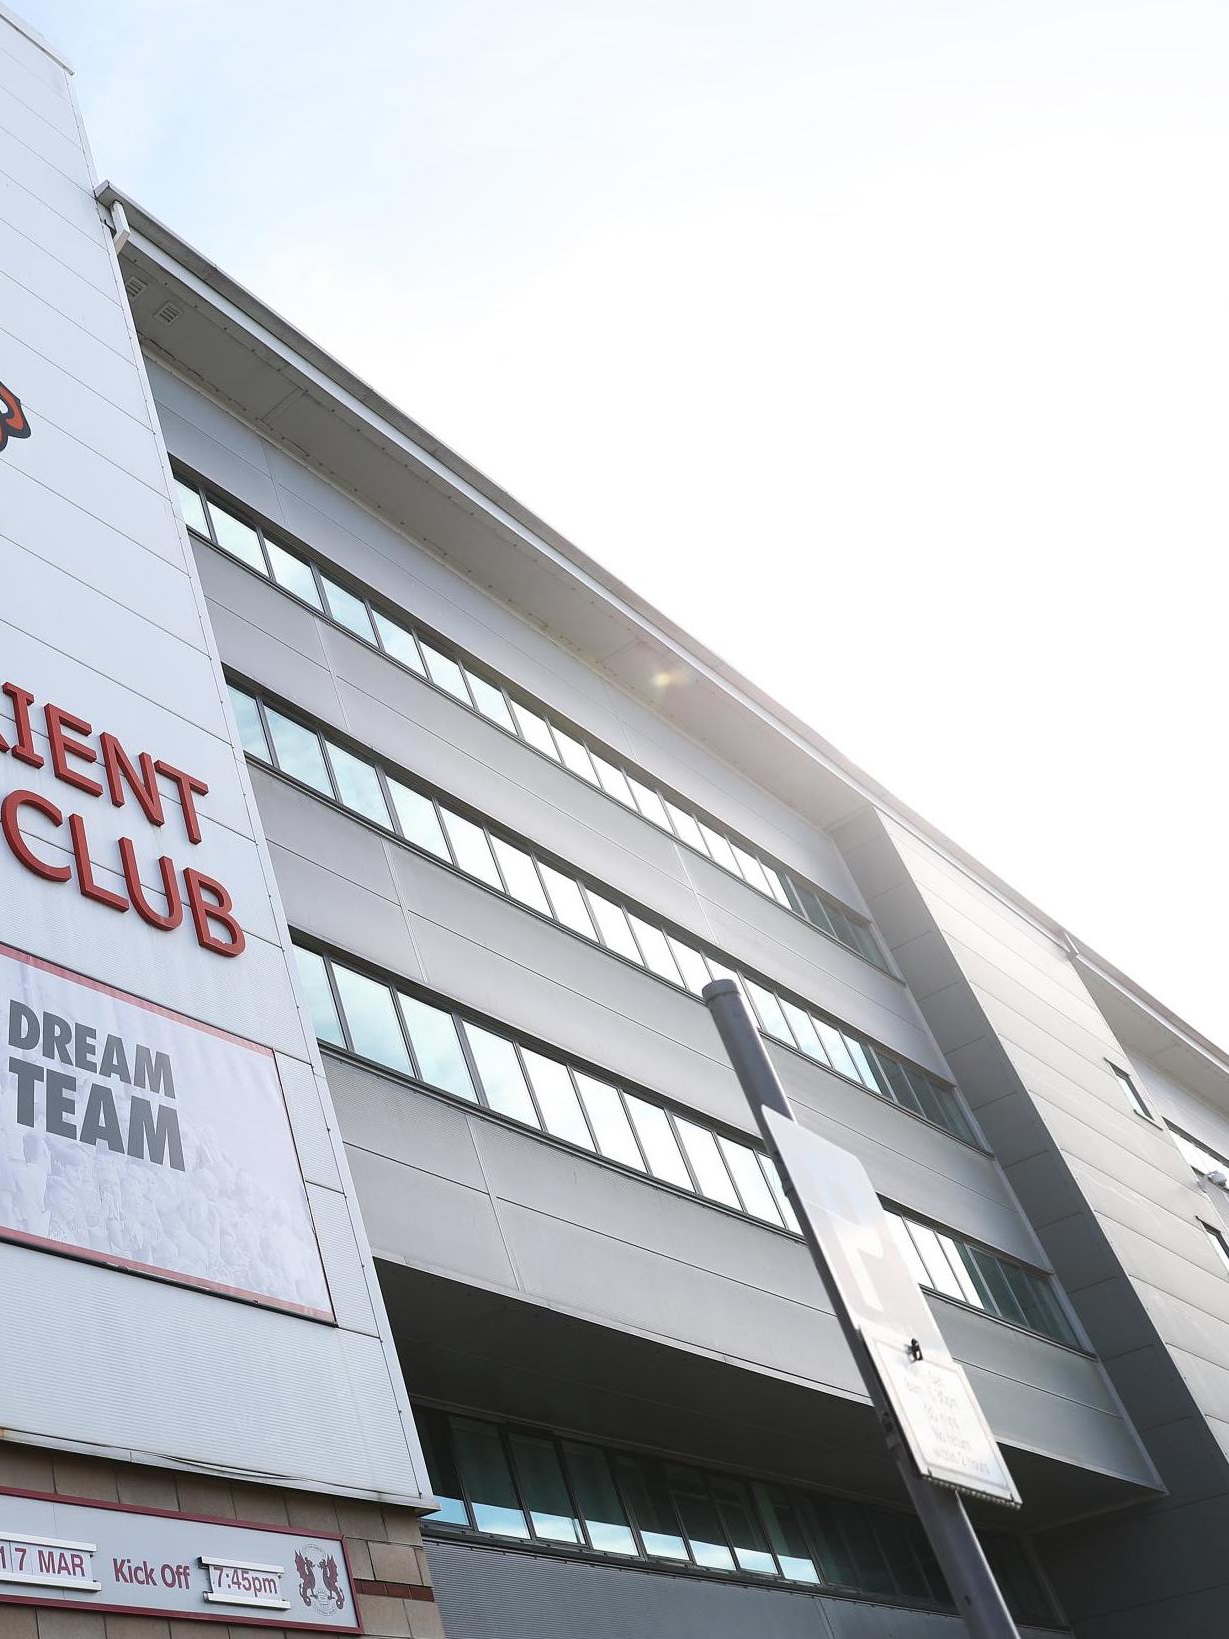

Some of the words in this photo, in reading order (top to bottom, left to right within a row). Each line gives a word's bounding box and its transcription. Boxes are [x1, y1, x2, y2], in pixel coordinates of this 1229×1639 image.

[0, 789, 246, 958] CLUB
[8, 999, 176, 1100] DREAM
[8, 1056, 186, 1172] TEAM
[38, 1550, 86, 1577] MAR
[113, 1558, 156, 1586] Kick
[161, 1563, 191, 1590] Off
[213, 1566, 278, 1596] 7:45pm
